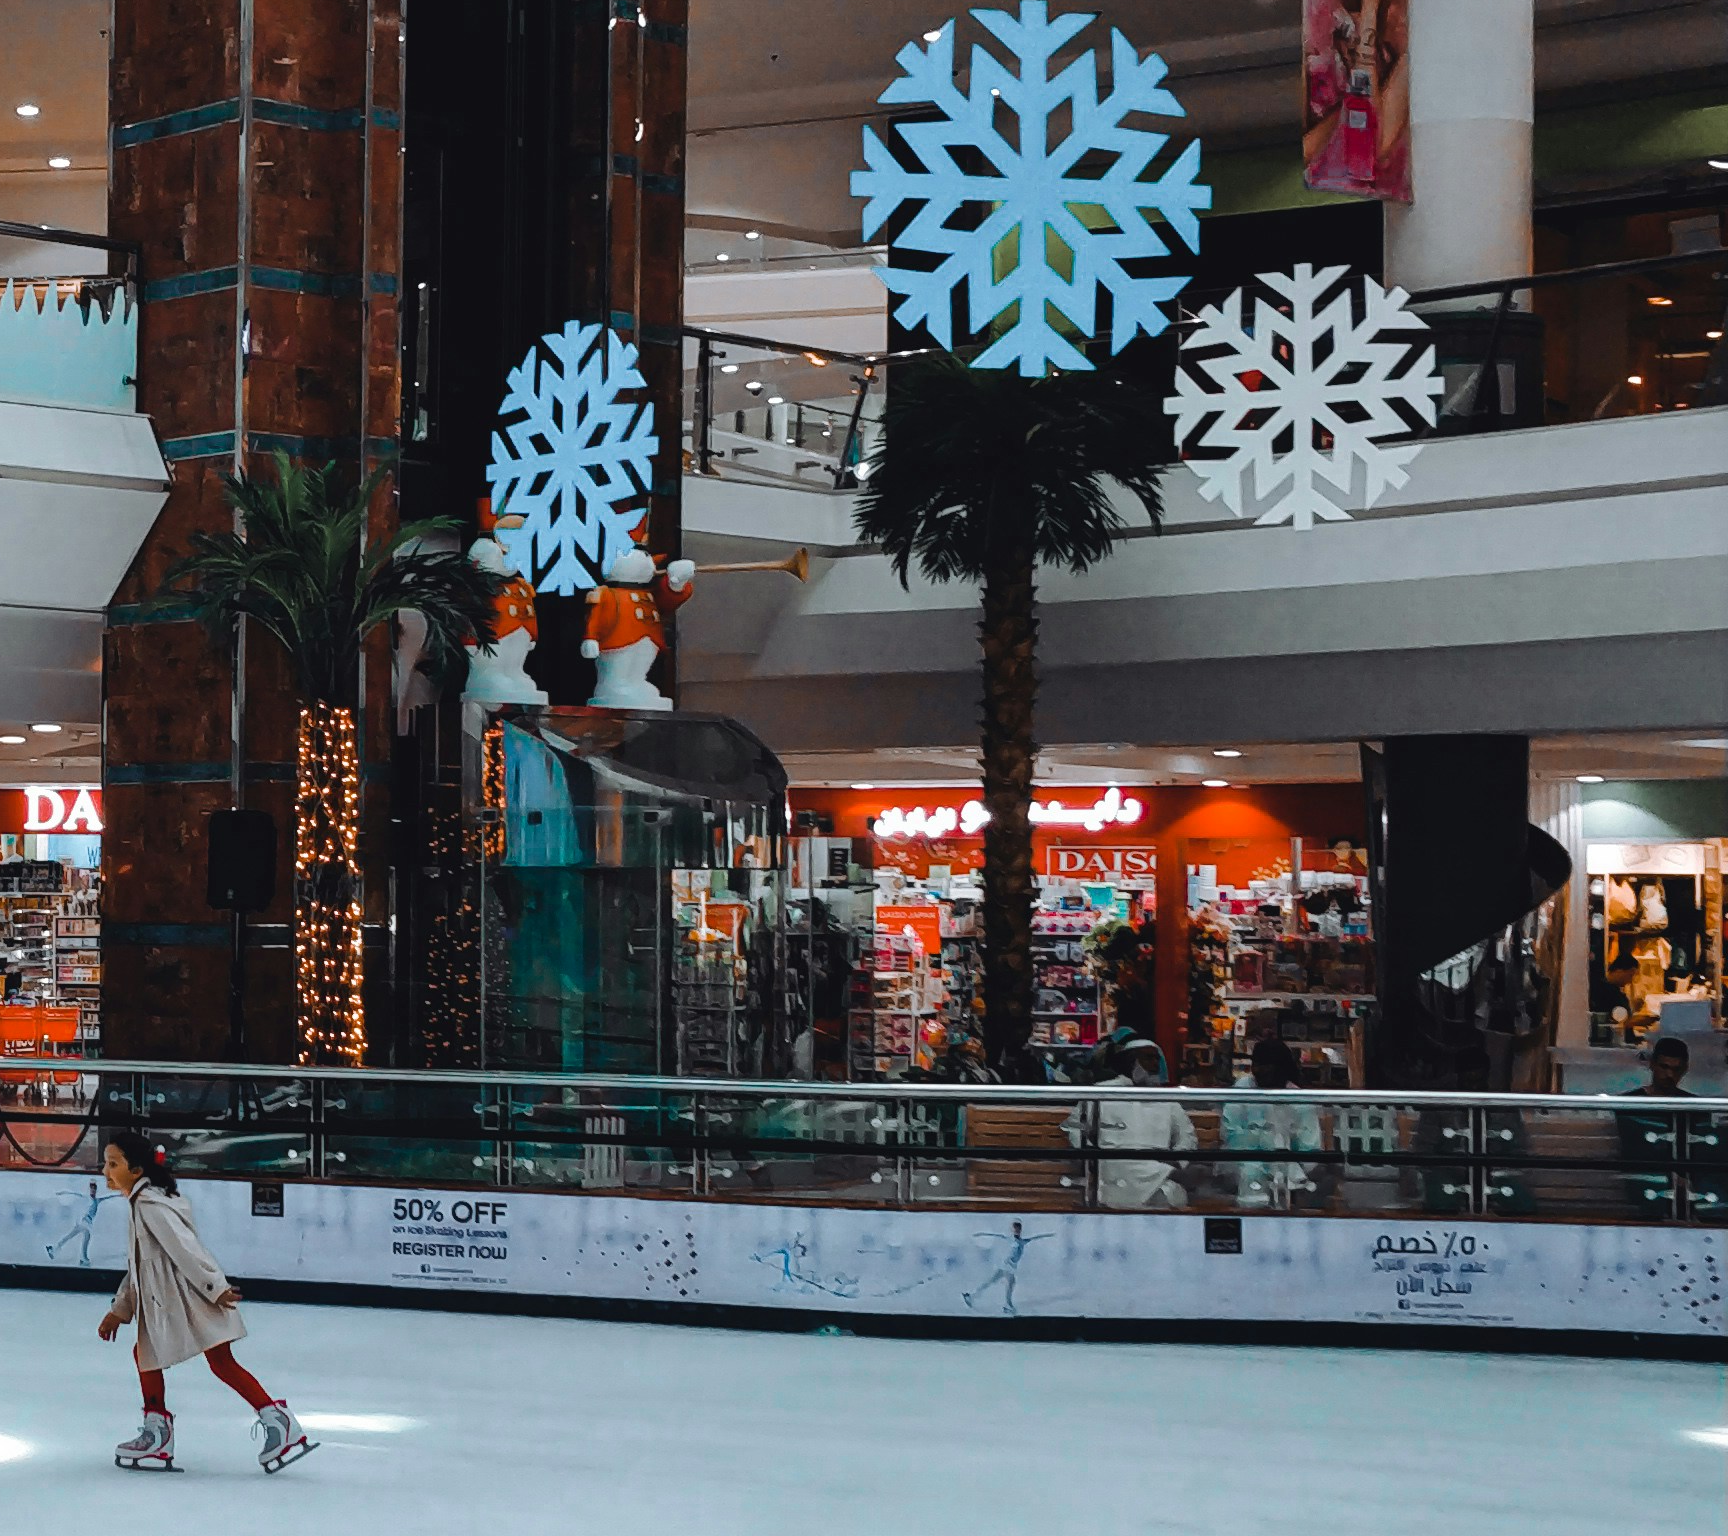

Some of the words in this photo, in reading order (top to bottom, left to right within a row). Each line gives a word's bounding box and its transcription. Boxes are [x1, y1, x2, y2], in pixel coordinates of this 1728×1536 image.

[393, 1198, 444, 1222] 50%
[452, 1200, 508, 1224] OFF
[392, 1241, 465, 1258] REGISTER
